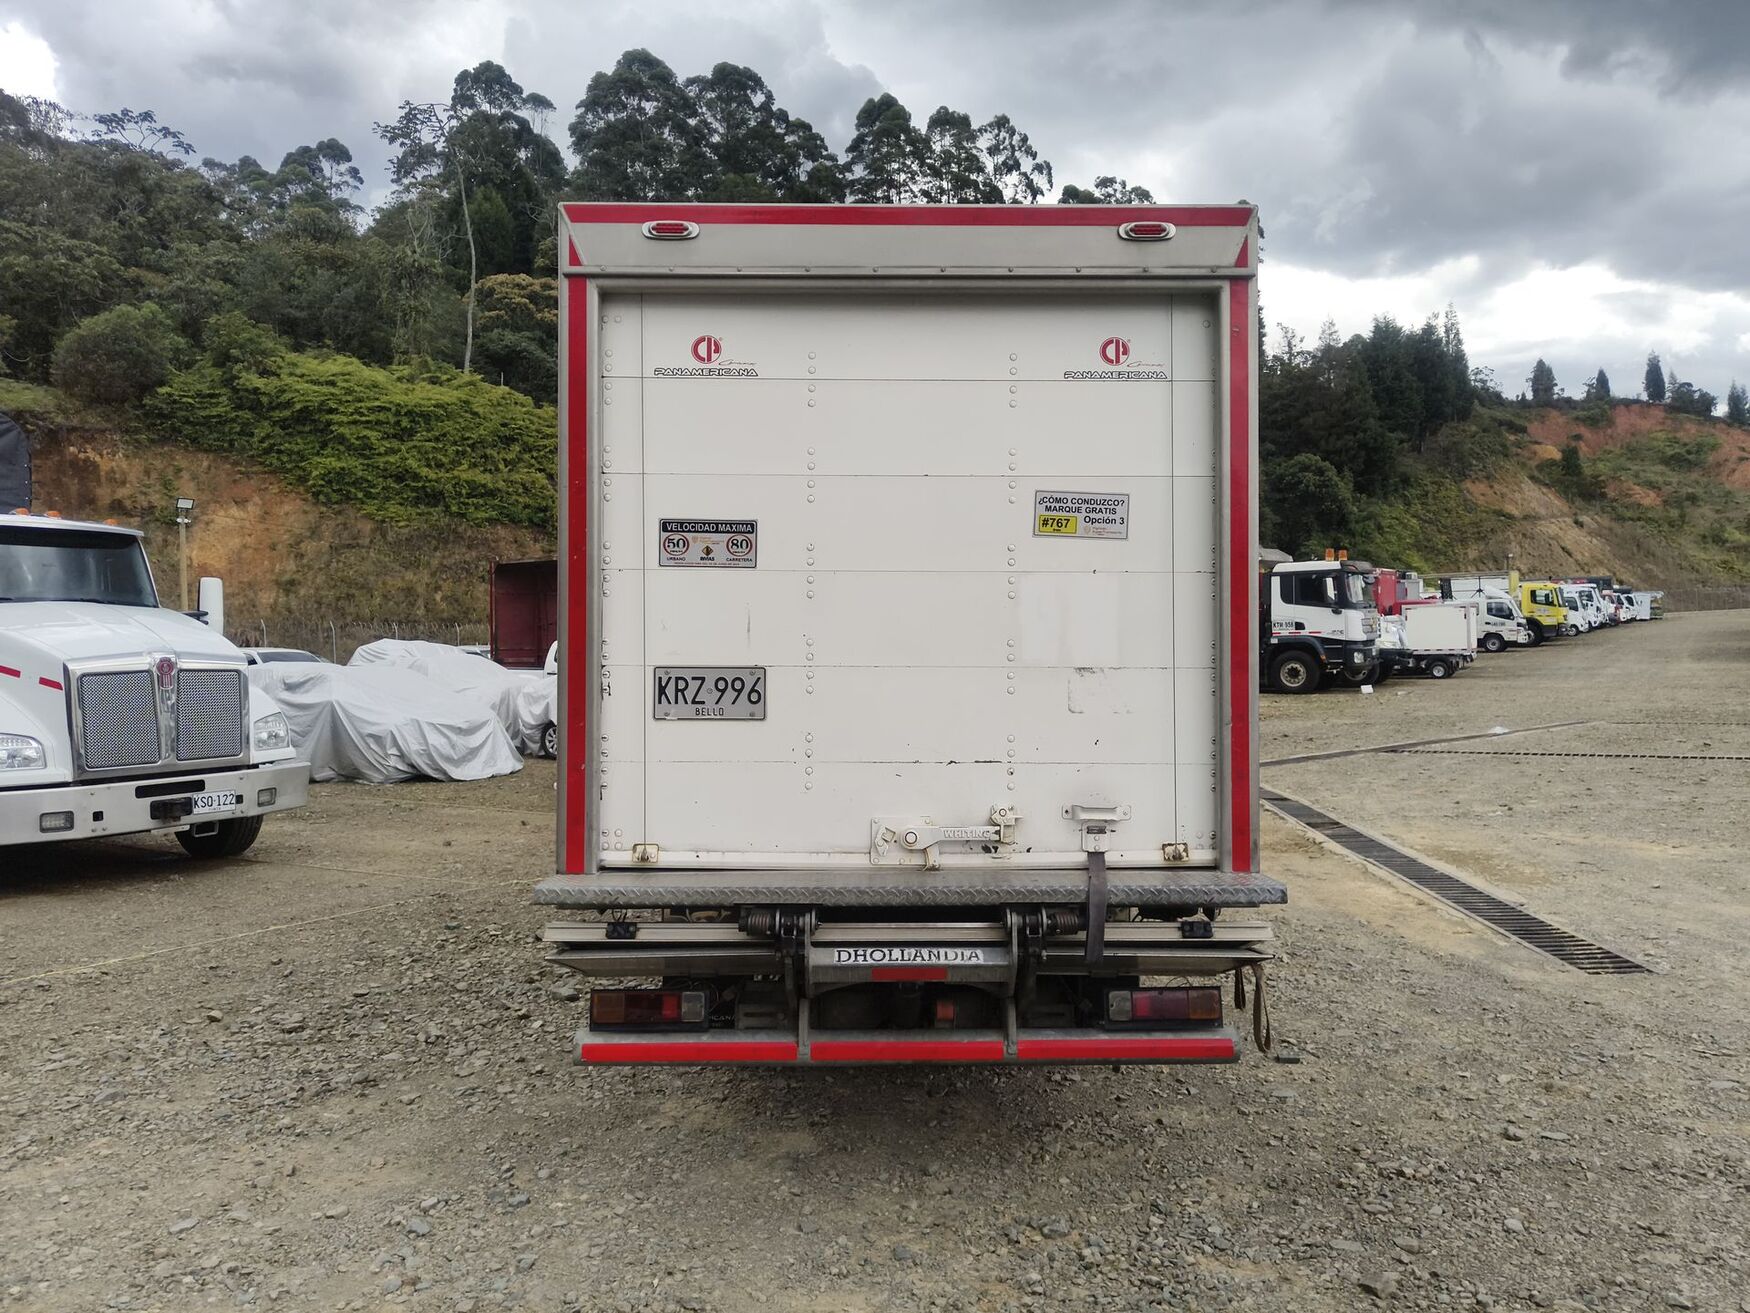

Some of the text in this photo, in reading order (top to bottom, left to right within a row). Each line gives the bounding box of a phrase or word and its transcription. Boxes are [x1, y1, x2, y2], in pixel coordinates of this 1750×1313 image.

[654, 367, 759, 377] PANAMERICANA
[1064, 371, 1168, 380] PANAMERICANA
[1039, 495, 1125, 507] ¿CÓMO CONDUZCO?
[1045, 505, 1117, 515] MARQUE GRATIS
[666, 522, 753, 532] VELOCIDAD MAXIMA
[1041, 515, 1125, 529] #767 Opción 3
[667, 538, 686, 549] 50
[730, 538, 749, 550] 80
[657, 676, 762, 705] KRZ 996
[695, 707, 724, 716] BELLO
[217, 794, 234, 806] 122
[943, 828, 991, 840] WHITING
[836, 949, 980, 962] DHOLLANDIA
